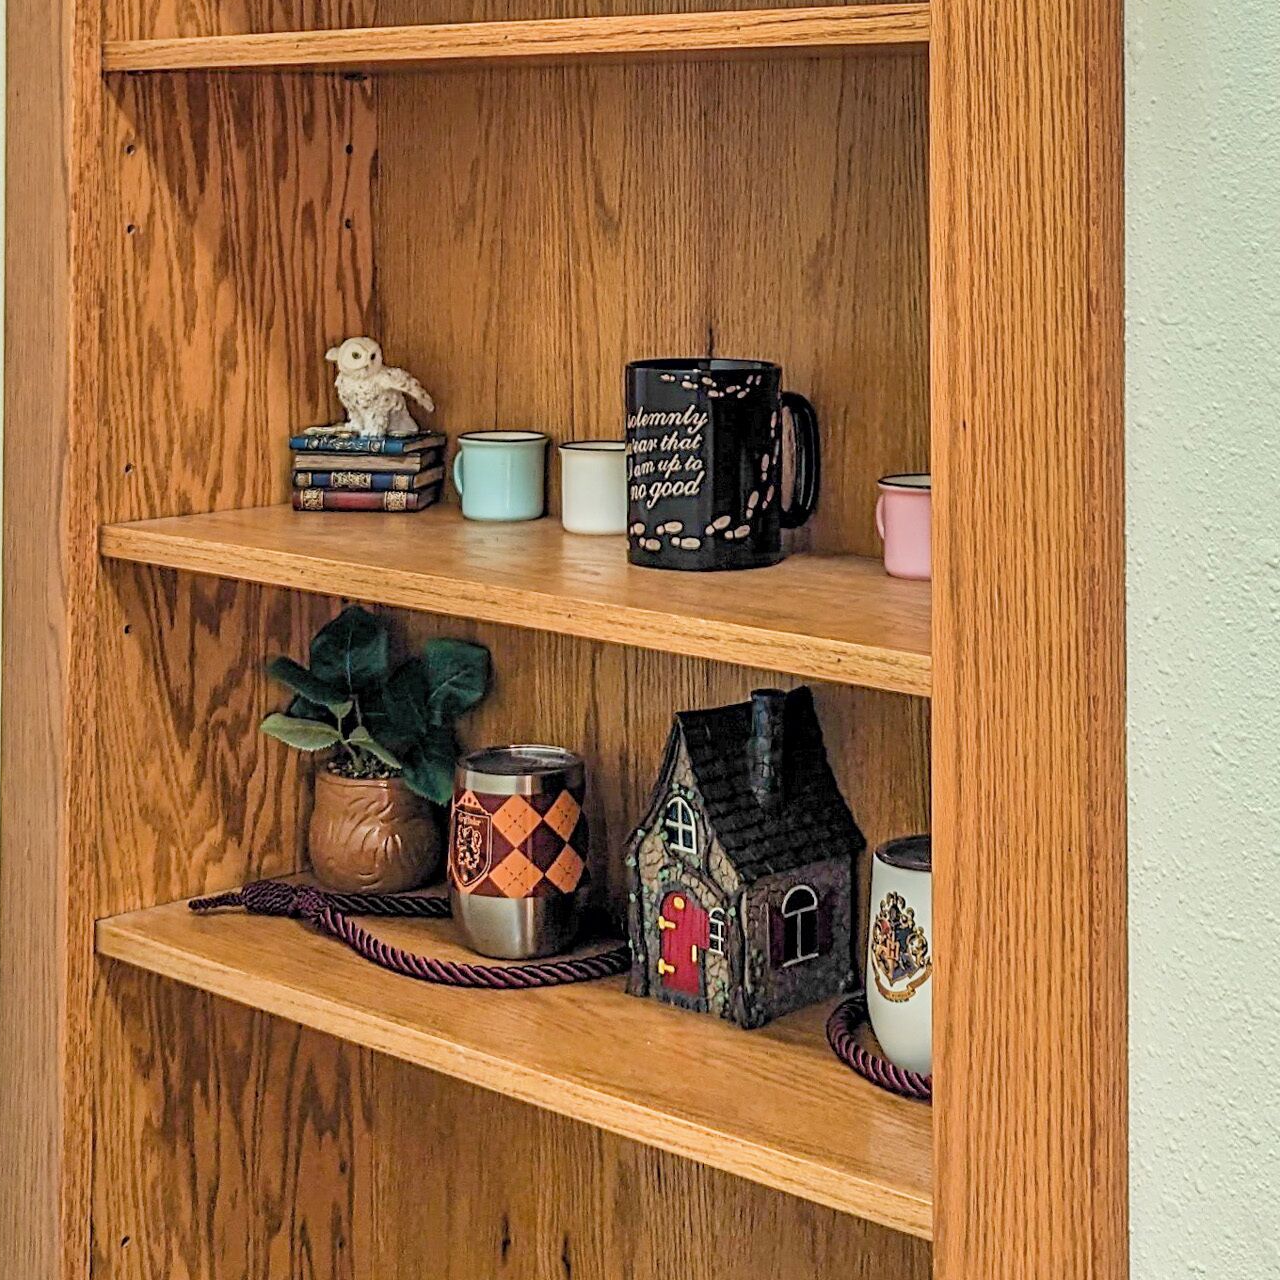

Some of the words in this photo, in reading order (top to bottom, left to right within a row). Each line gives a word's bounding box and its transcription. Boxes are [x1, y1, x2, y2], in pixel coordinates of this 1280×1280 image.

[660, 431, 703, 452] that
[633, 460, 655, 477] am
[658, 454, 682, 479] up
[684, 455, 703, 471] to
[630, 483, 647, 500] no
[646, 470, 706, 509] good
